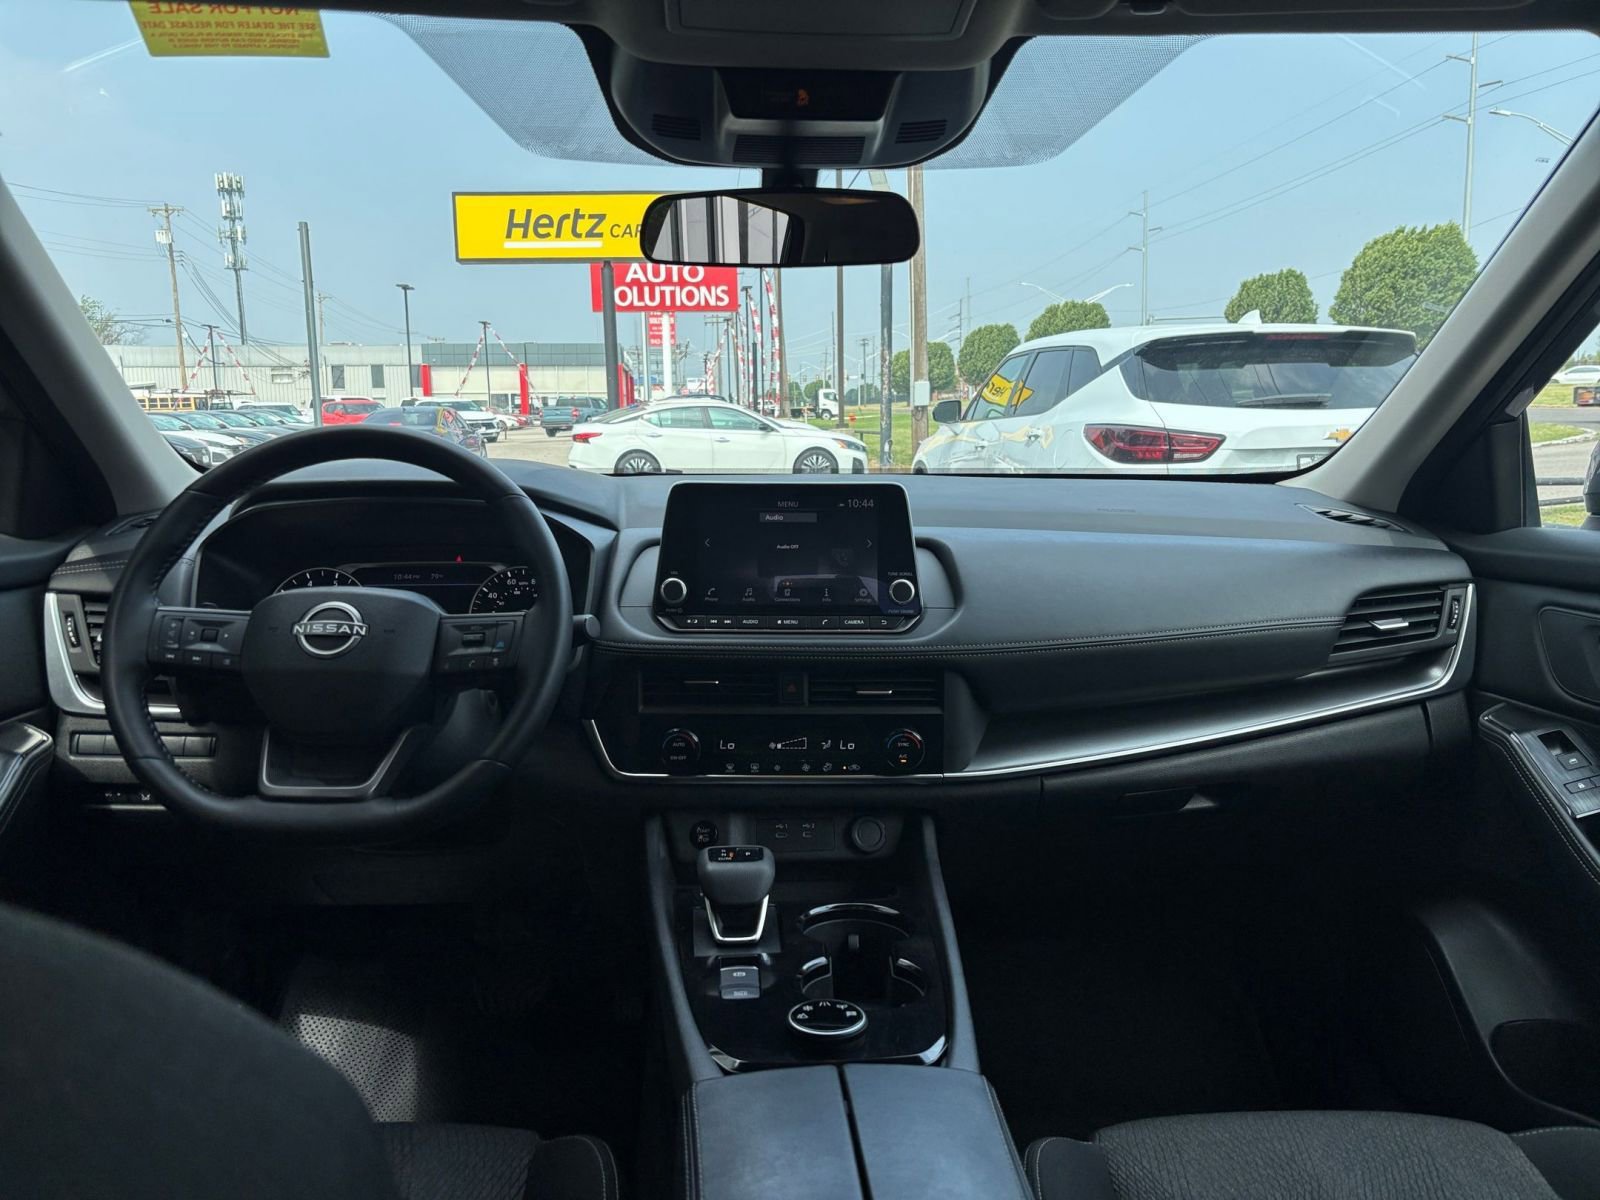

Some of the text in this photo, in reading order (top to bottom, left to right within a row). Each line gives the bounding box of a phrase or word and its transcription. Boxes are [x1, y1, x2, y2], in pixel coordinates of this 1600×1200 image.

[505, 208, 607, 239] Hertz
[625, 263, 705, 283] AUTO
[615, 285, 730, 308] OLUTIONS
[777, 500, 799, 508] MENU
[848, 499, 874, 508] 10:44
[293, 623, 367, 636] NISSAN
[719, 739, 735, 750] Lo
[839, 739, 855, 750] Lo
